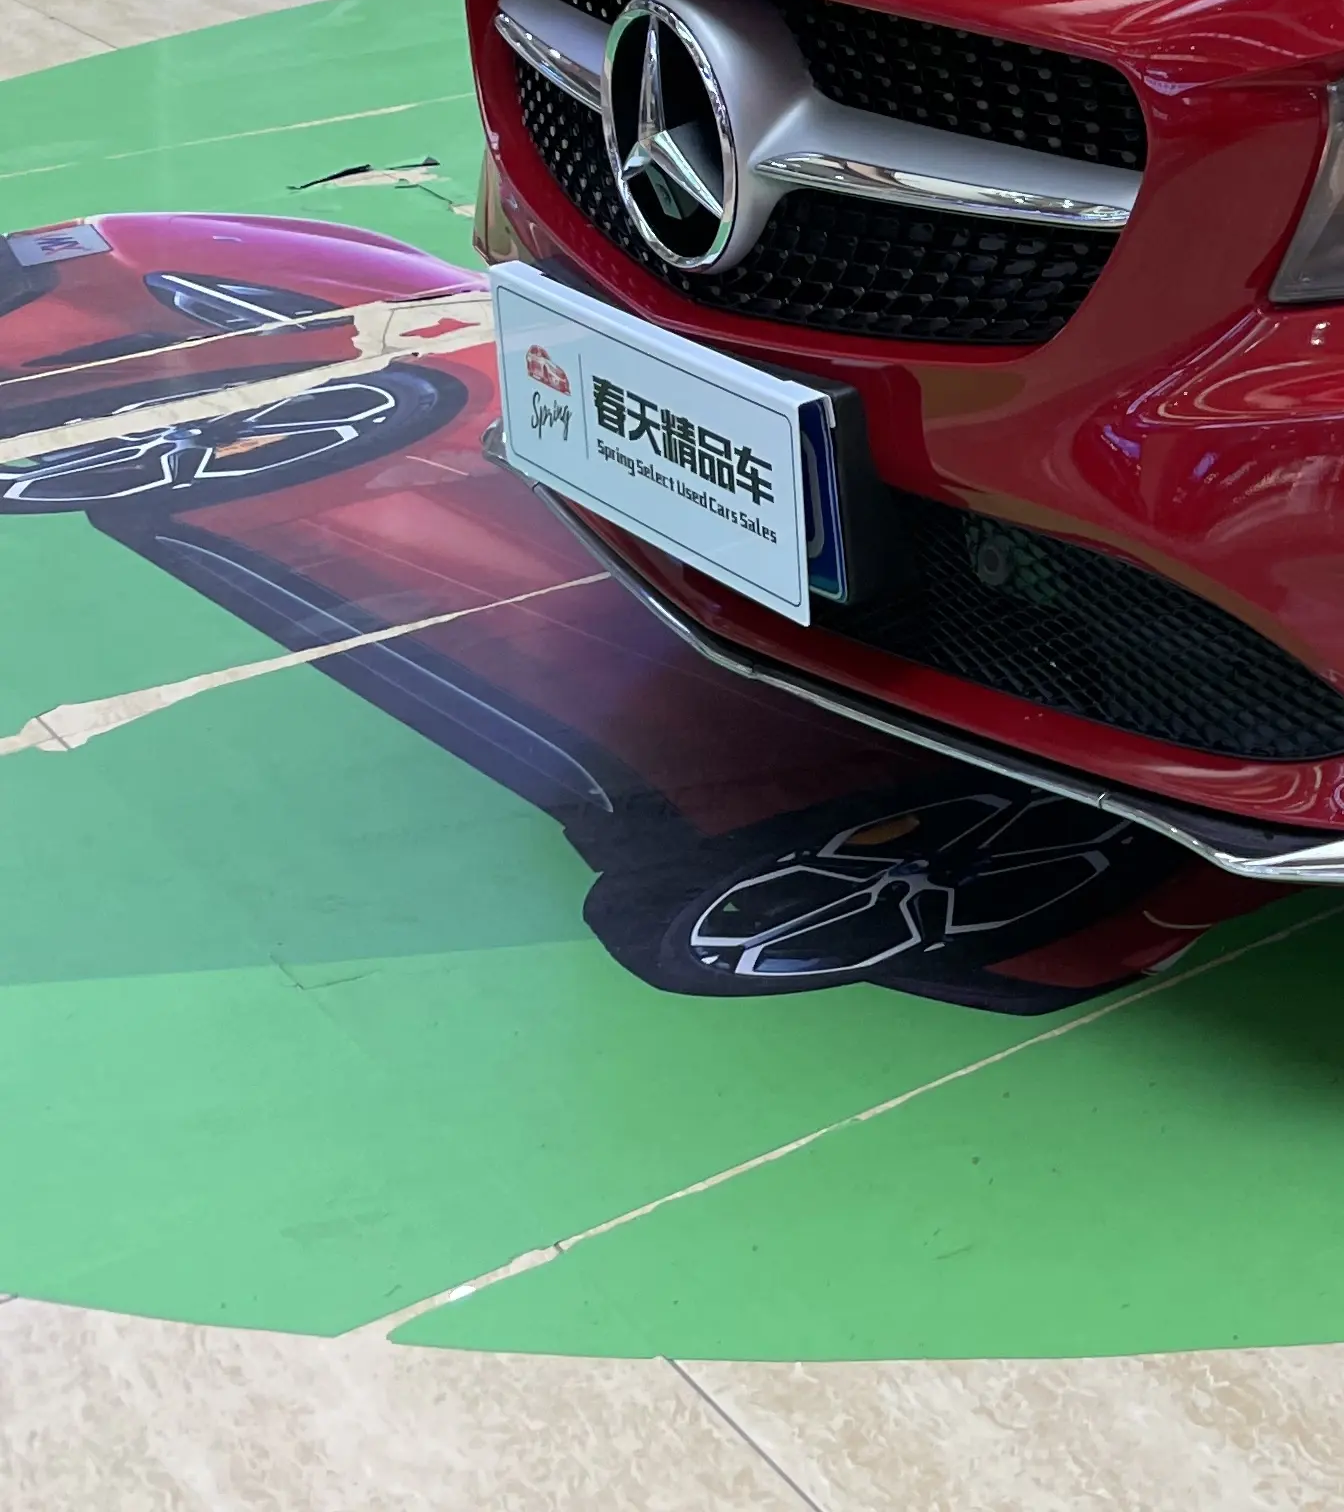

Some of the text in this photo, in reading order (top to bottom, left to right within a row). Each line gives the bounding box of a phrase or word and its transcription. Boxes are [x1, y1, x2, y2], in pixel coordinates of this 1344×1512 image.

[531, 391, 573, 442] Spring
[592, 375, 775, 506] 春天精品车
[597, 438, 778, 544] Spring Select Used Cars Sales
